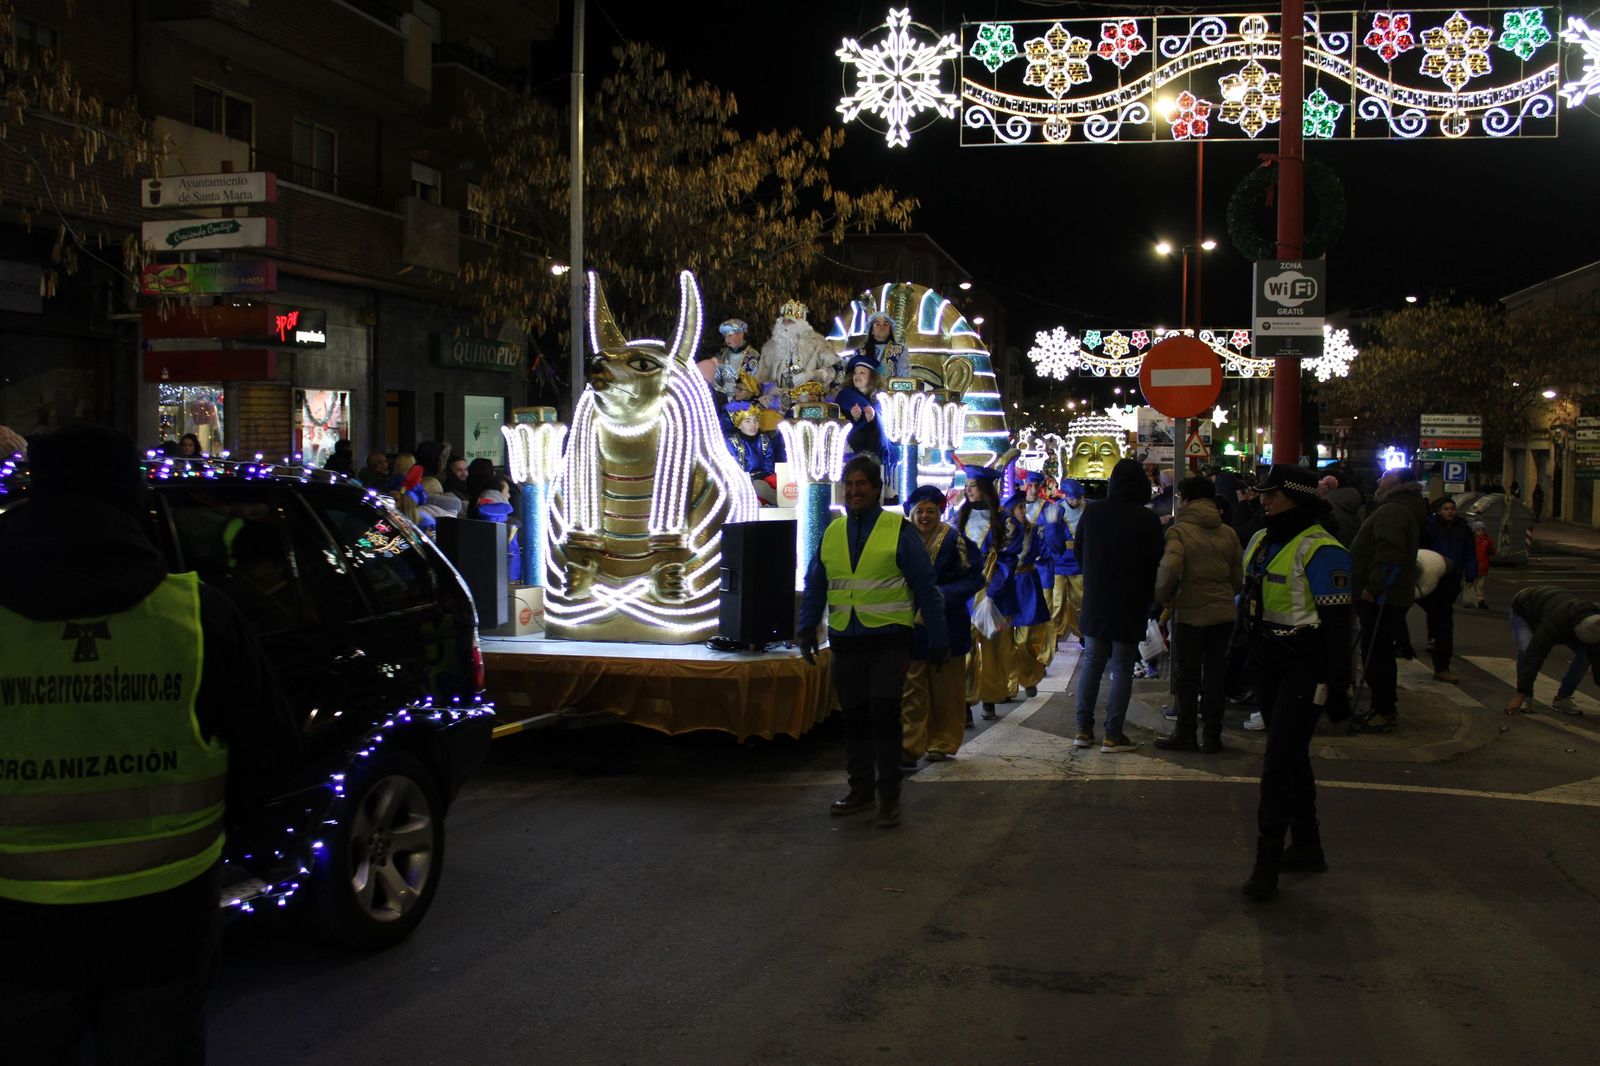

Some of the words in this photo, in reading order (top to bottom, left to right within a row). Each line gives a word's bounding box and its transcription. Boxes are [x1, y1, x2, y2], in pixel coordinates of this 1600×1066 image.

[178, 177, 248, 191] Ayuntamiento
[178, 193, 191, 203] de
[193, 191, 220, 201] Santa
[223, 190, 253, 201] Marta
[1280, 262, 1303, 270] ZONA
[1277, 308, 1304, 316] GRATIS
[1448, 463, 1462, 480] P
